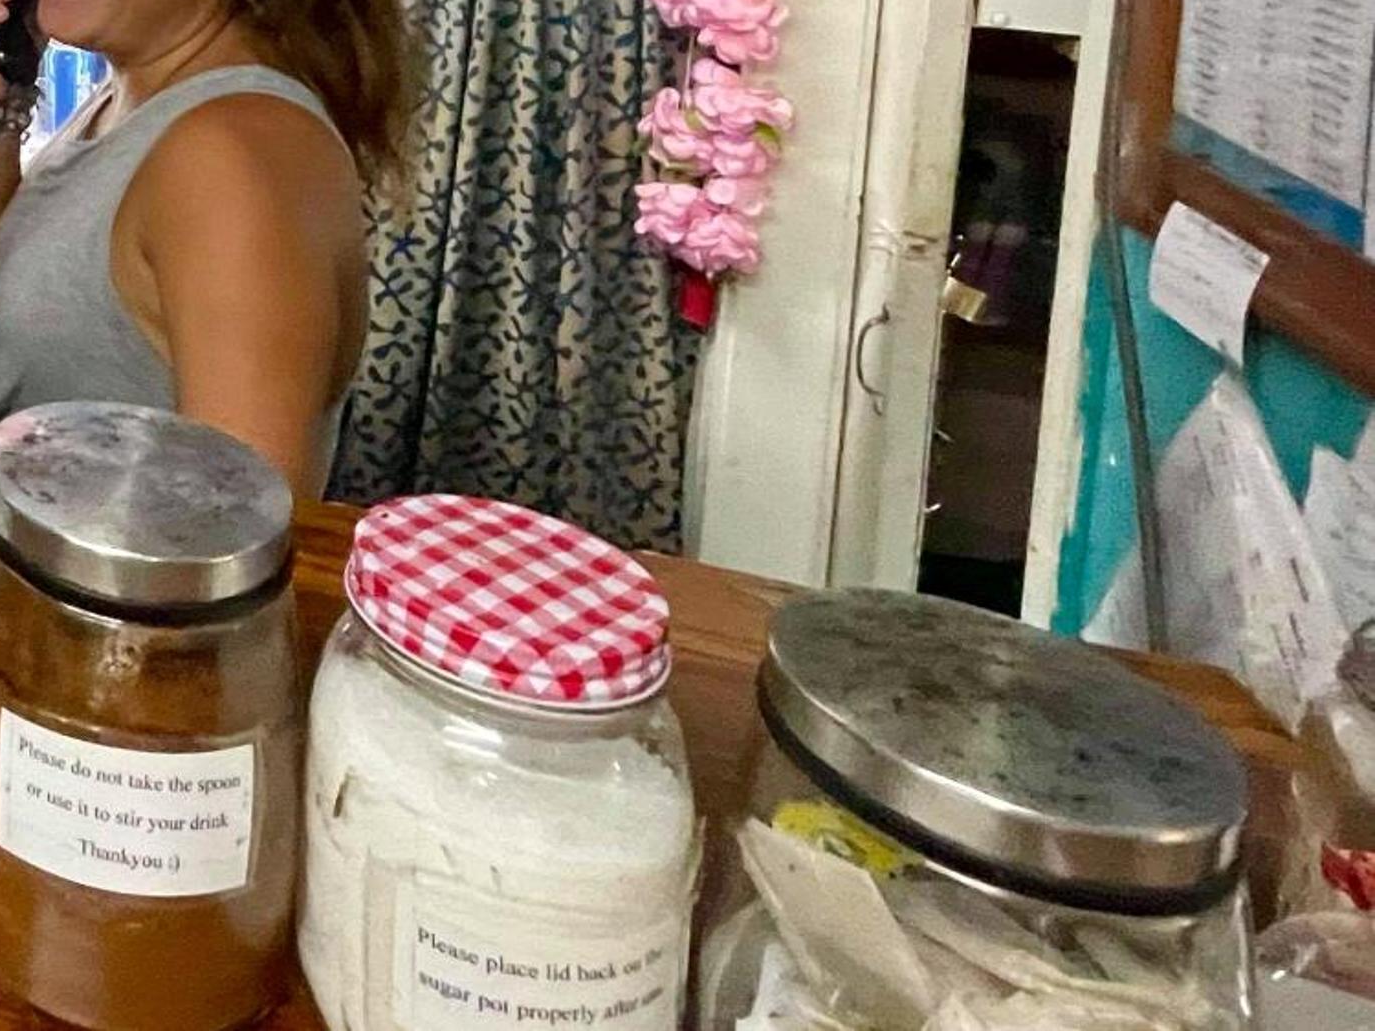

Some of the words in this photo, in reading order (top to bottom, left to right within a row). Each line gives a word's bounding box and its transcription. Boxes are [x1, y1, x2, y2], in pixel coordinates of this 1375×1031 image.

[18, 735, 66, 771] Please
[70, 759, 92, 778] do
[96, 769, 124, 786] not
[129, 774, 164, 793] take
[168, 775, 193, 793] the
[197, 774, 242, 795] spoon
[26, 784, 42, 799] or
[46, 790, 73, 812] use
[77, 800, 89, 817] it
[94, 806, 111, 823] to
[115, 810, 142, 828] stir
[146, 817, 186, 834] your
[189, 812, 230, 831] drink
[78, 837, 164, 870] Thankyou
[417, 926, 480, 966] Please
[485, 955, 539, 980] place
[545, 963, 571, 982] lid
[577, 962, 617, 982] back
[418, 969, 471, 1002] sugar
[477, 994, 509, 1015] pot
[516, 1004, 597, 1026] properly
